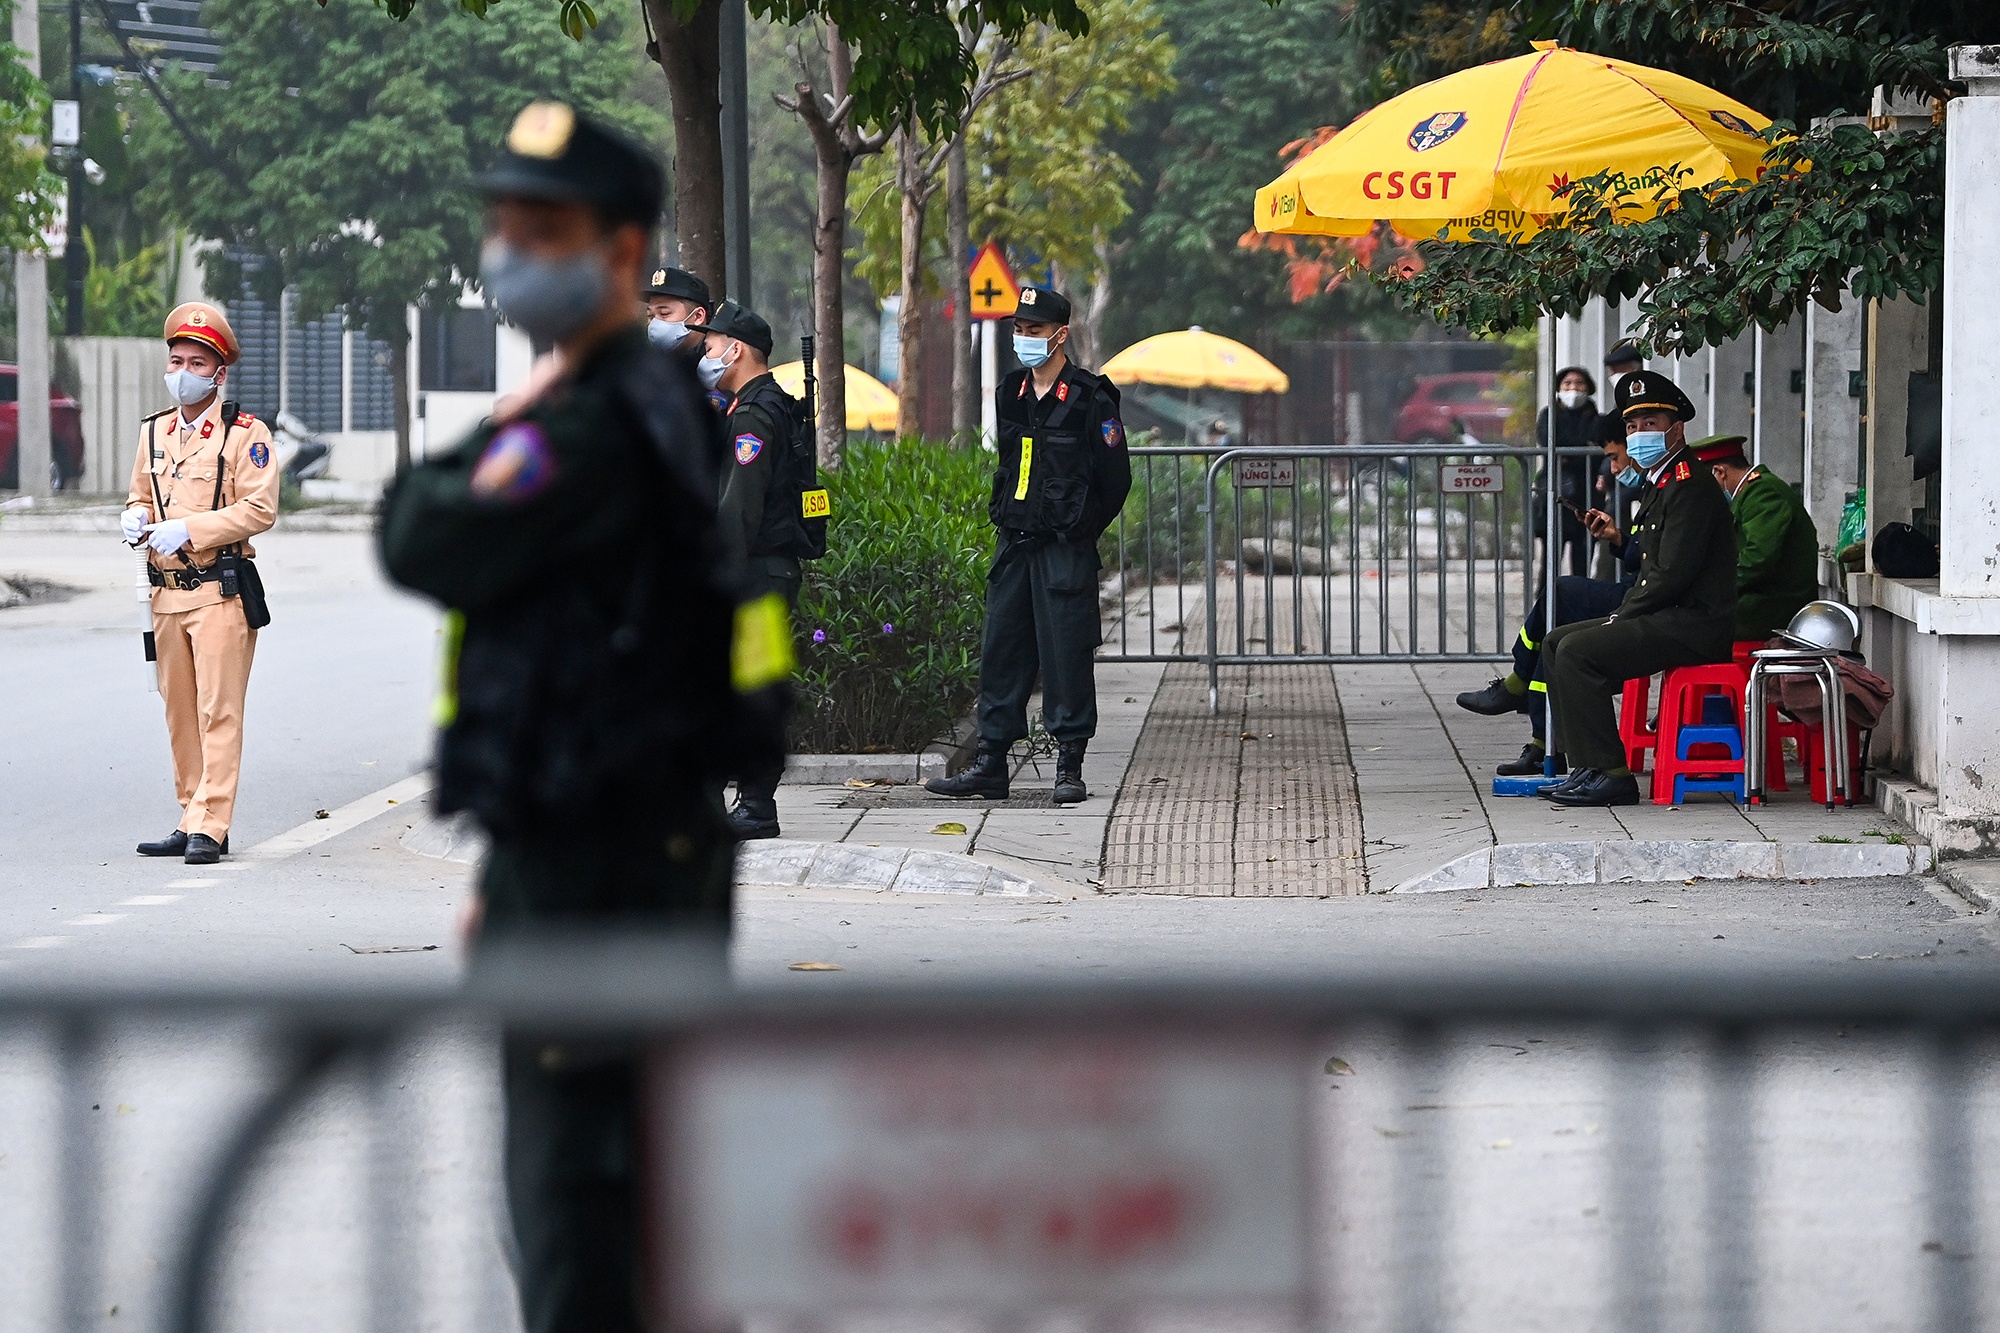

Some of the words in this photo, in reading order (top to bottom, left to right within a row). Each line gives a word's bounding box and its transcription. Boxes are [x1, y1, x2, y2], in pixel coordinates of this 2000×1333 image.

[1362, 171, 1457, 200] CSGT
[1582, 169, 1670, 195] Bank
[1453, 477, 1491, 488] STOP
